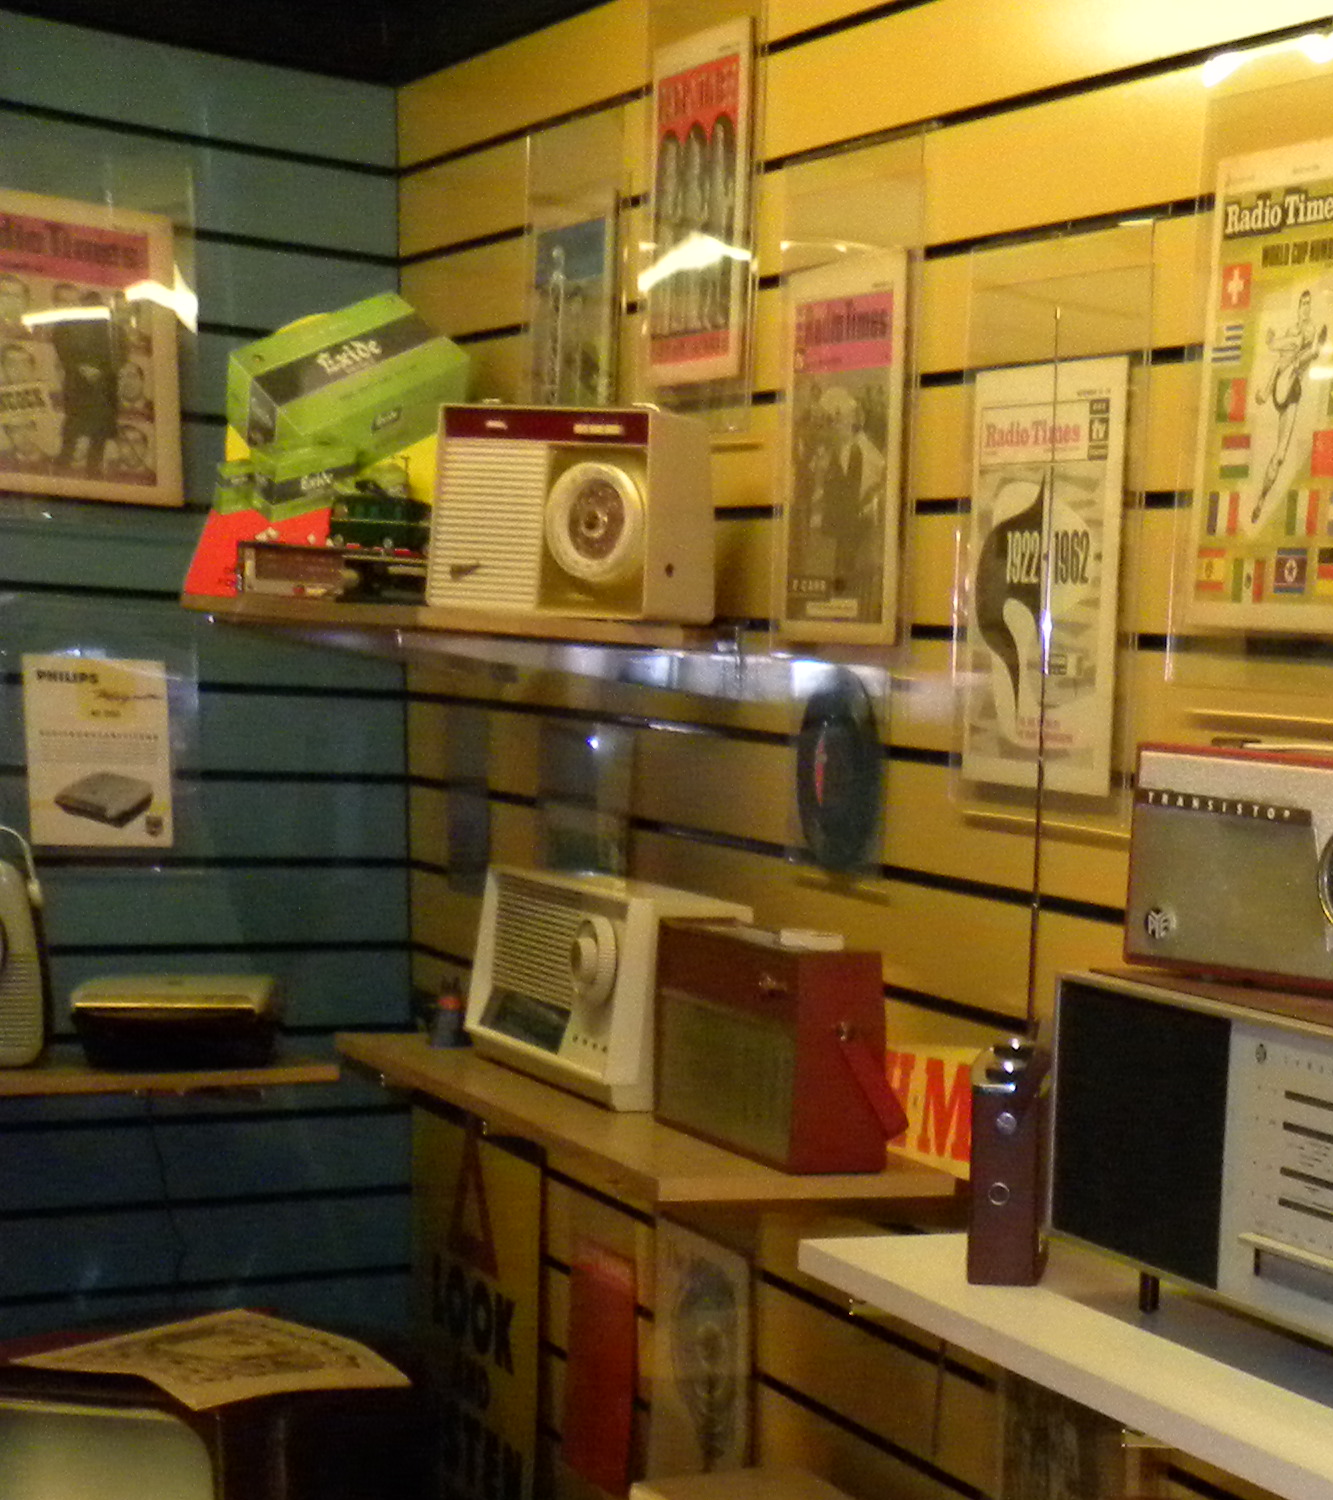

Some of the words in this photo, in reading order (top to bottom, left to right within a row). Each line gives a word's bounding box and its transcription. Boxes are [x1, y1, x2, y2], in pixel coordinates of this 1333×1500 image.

[1225, 199, 1282, 234] Radio
[316, 340, 383, 397] Exide
[985, 420, 1030, 449] Radio
[1032, 418, 1081, 446] Times
[1006, 529, 1040, 584] 1922
[1054, 529, 1090, 585] 1962
[37, 669, 99, 684] PHILIPS
